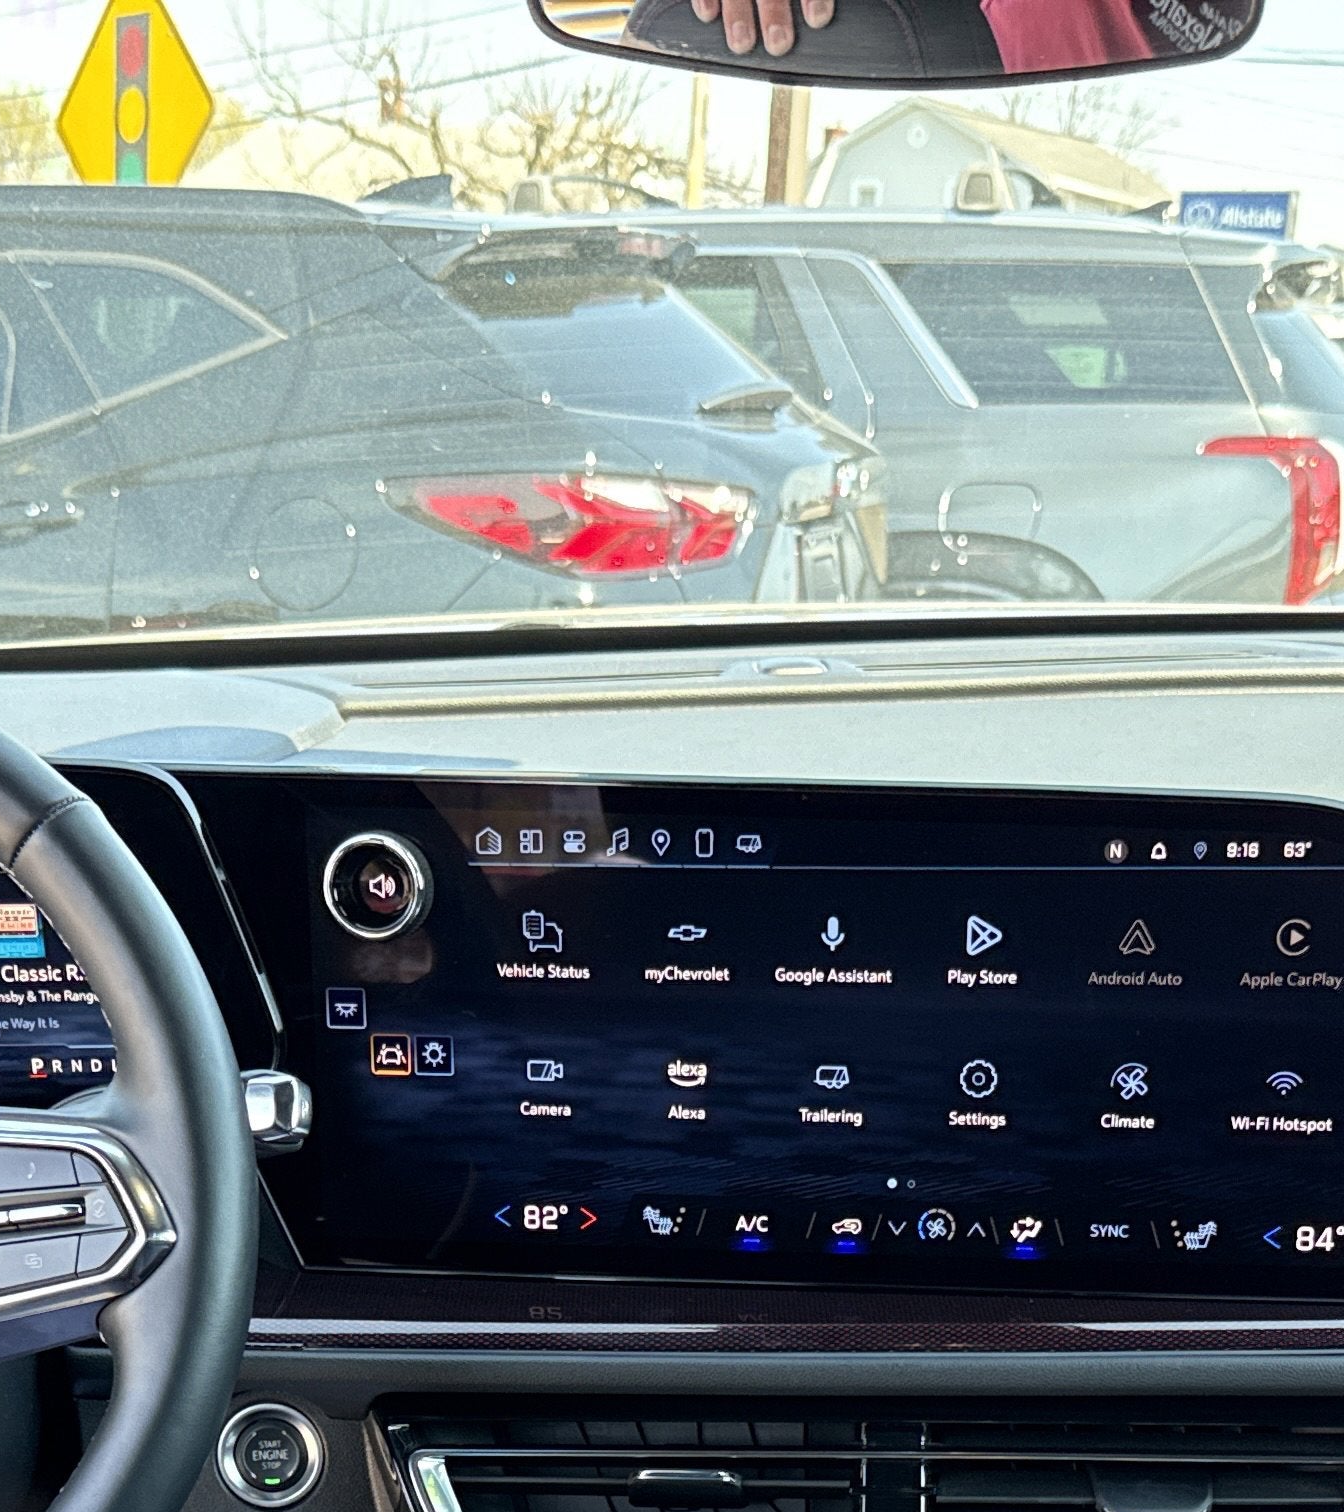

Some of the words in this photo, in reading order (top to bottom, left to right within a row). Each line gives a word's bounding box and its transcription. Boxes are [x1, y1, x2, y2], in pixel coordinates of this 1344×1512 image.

[0, 965, 63, 983] Classic
[497, 963, 547, 980] Vehicle
[549, 964, 591, 981] Status
[644, 965, 730, 984] myChevrolet
[775, 967, 823, 986] Google
[827, 967, 892, 984] Assistant
[947, 969, 977, 987] Play
[979, 969, 1017, 985] Store
[1088, 971, 1145, 987] Android
[1148, 971, 1182, 987] Auto
[1240, 972, 1283, 990] Apple
[1286, 972, 1344, 991] CarPlay
[27, 991, 37, 1003] &
[38, 990, 62, 1003] The
[10, 1017, 36, 1032] Way
[37, 1017, 48, 1029] It
[49, 1017, 60, 1029] Is
[30, 1058, 45, 1074] P
[51, 1059, 64, 1073] R
[71, 1059, 83, 1072] N
[90, 1058, 103, 1072] D
[667, 1060, 707, 1080] alexa
[520, 1101, 572, 1118] Camera
[668, 1104, 706, 1122] Alexa
[799, 1108, 863, 1127] Trailering
[949, 1110, 1006, 1129] Settings
[1100, 1113, 1155, 1130] Climate
[1231, 1115, 1270, 1132] Wi-Fi
[1272, 1115, 1333, 1134] Hotspot
[735, 1215, 769, 1233] A/C
[1090, 1223, 1130, 1239] SYNC
[258, 1440, 281, 1449] START
[251, 1449, 289, 1461] ENGINE
[261, 1461, 282, 1470] STOP
